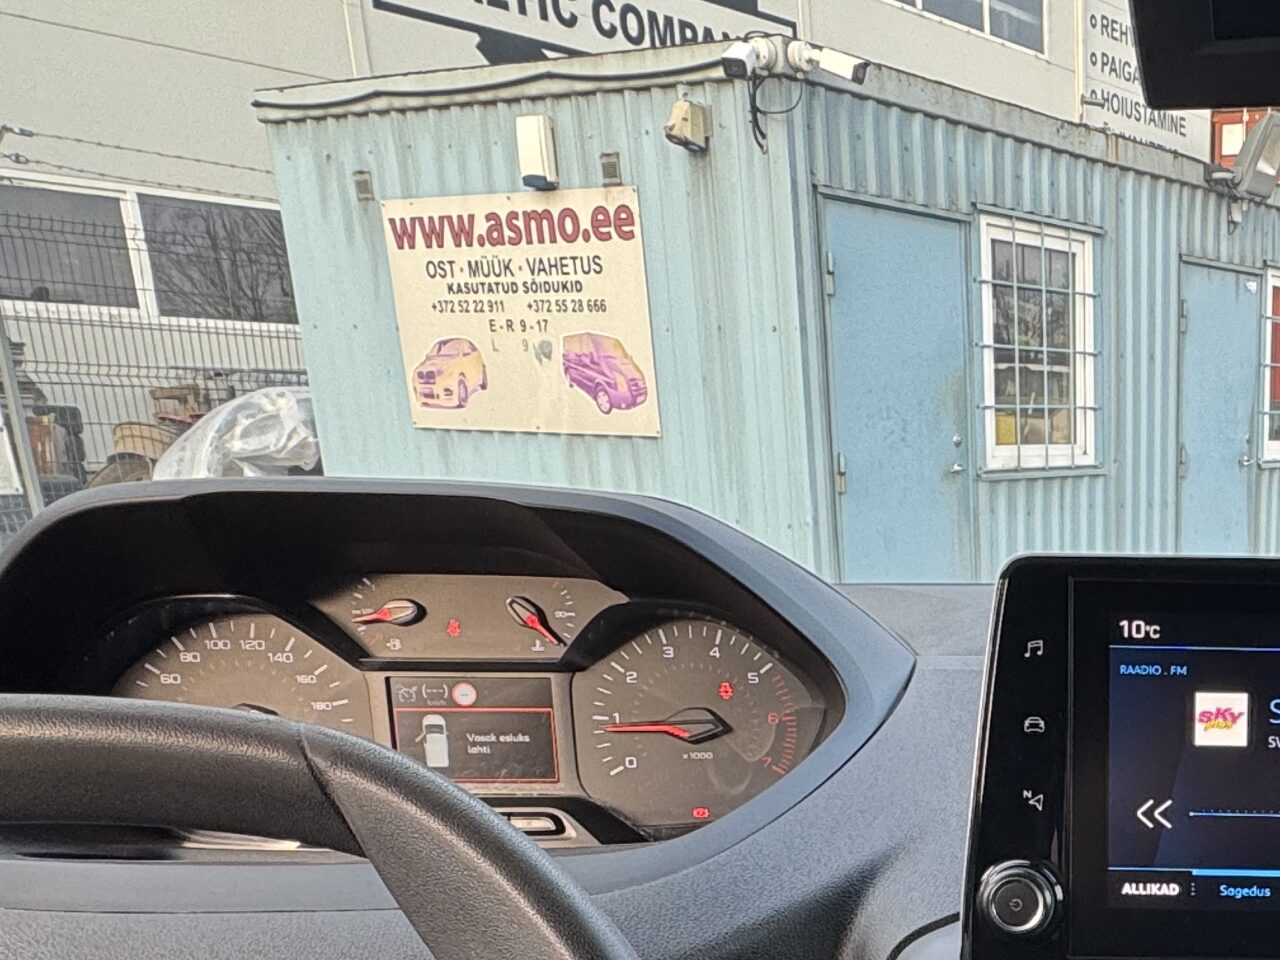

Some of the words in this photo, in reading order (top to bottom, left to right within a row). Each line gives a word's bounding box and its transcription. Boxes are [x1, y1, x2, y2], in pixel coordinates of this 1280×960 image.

[388, 203, 636, 250] www.asmo.ee
[425, 260, 456, 279] OST
[467, 255, 514, 278] MÜÜK
[525, 255, 603, 276] VAHETUS
[447, 280, 519, 295] KASUTATUD
[522, 278, 583, 294] SÕIDUKID
[431, 301, 456, 313] +372
[458, 300, 471, 313] 52
[473, 300, 485, 313] 22
[487, 300, 505, 312] 911
[527, 300, 553, 312] +372
[555, 300, 569, 312] 55
[571, 299, 585, 312] 28
[587, 299, 607, 312] 666
[1119, 620, 1161, 639] 10°C
[204, 639, 231, 650] 100
[239, 639, 266, 650] 120
[179, 652, 201, 663] 80
[267, 652, 294, 663] 140
[662, 646, 674, 659] 3
[709, 646, 721, 658] 4
[1119, 665, 1161, 675] RAADIO
[1170, 666, 1187, 675] FM
[160, 673, 181, 685] 60
[295, 674, 317, 684] 160
[626, 671, 637, 684] 2
[747, 672, 760, 684] 5
[310, 701, 332, 710] 180
[612, 712, 620, 724] 1
[767, 712, 780, 725] 6
[625, 755, 637, 768] 0
[761, 756, 772, 768] 7
[1121, 882, 1180, 896] ALLIKAD
[1219, 884, 1271, 899] Sagedus
